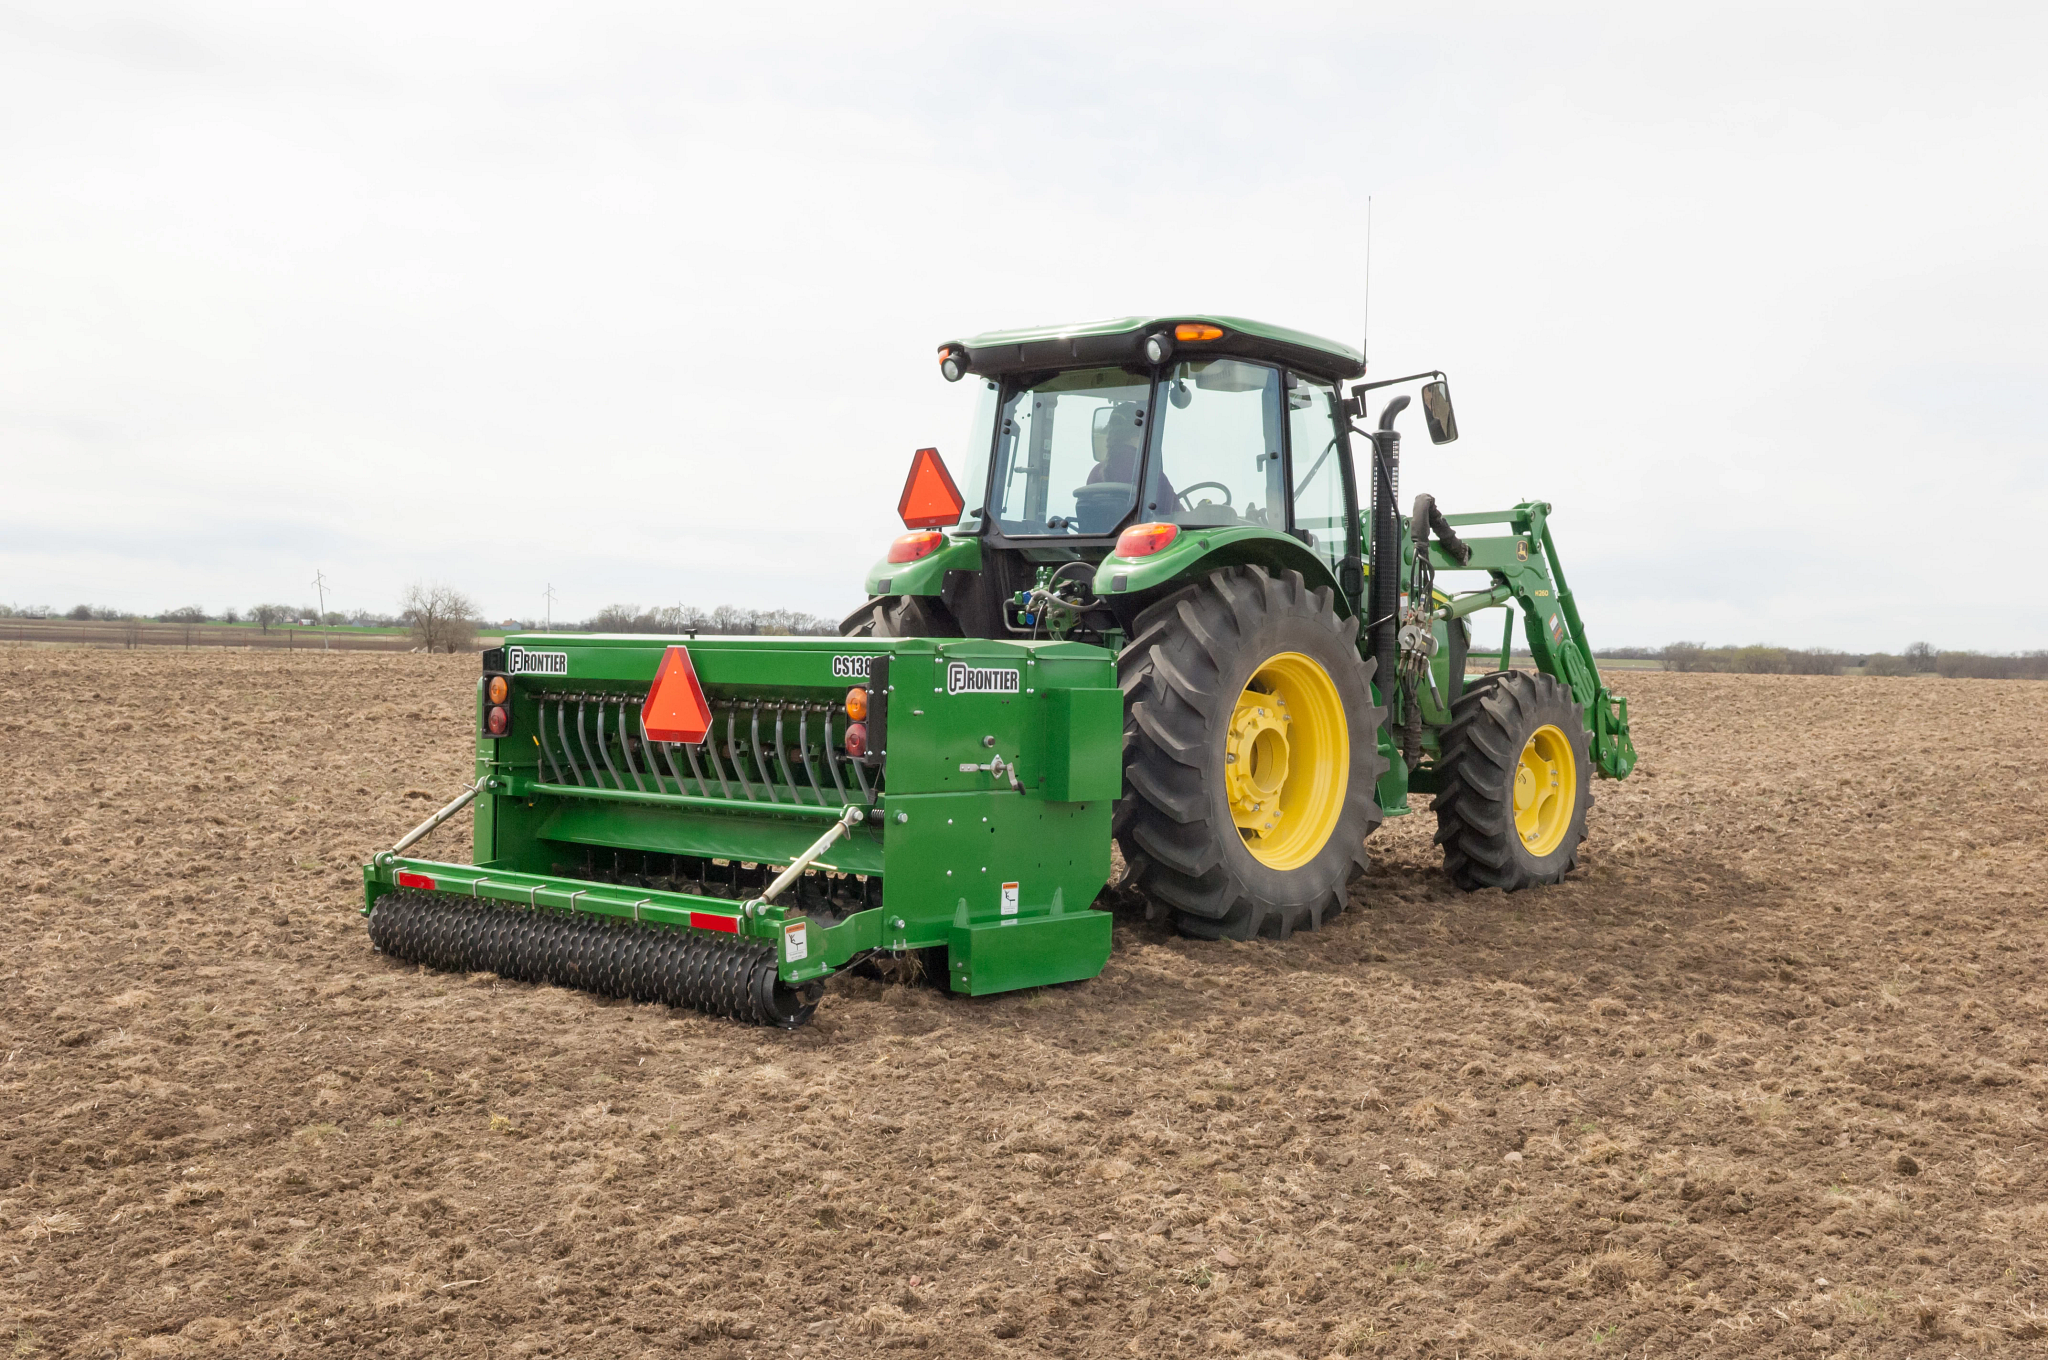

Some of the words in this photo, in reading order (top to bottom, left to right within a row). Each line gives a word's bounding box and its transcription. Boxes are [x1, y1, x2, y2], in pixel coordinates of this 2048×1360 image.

[510, 648, 567, 674] FRONTIER
[833, 657, 872, 676] CS138
[949, 663, 1018, 693] FRONTIER
